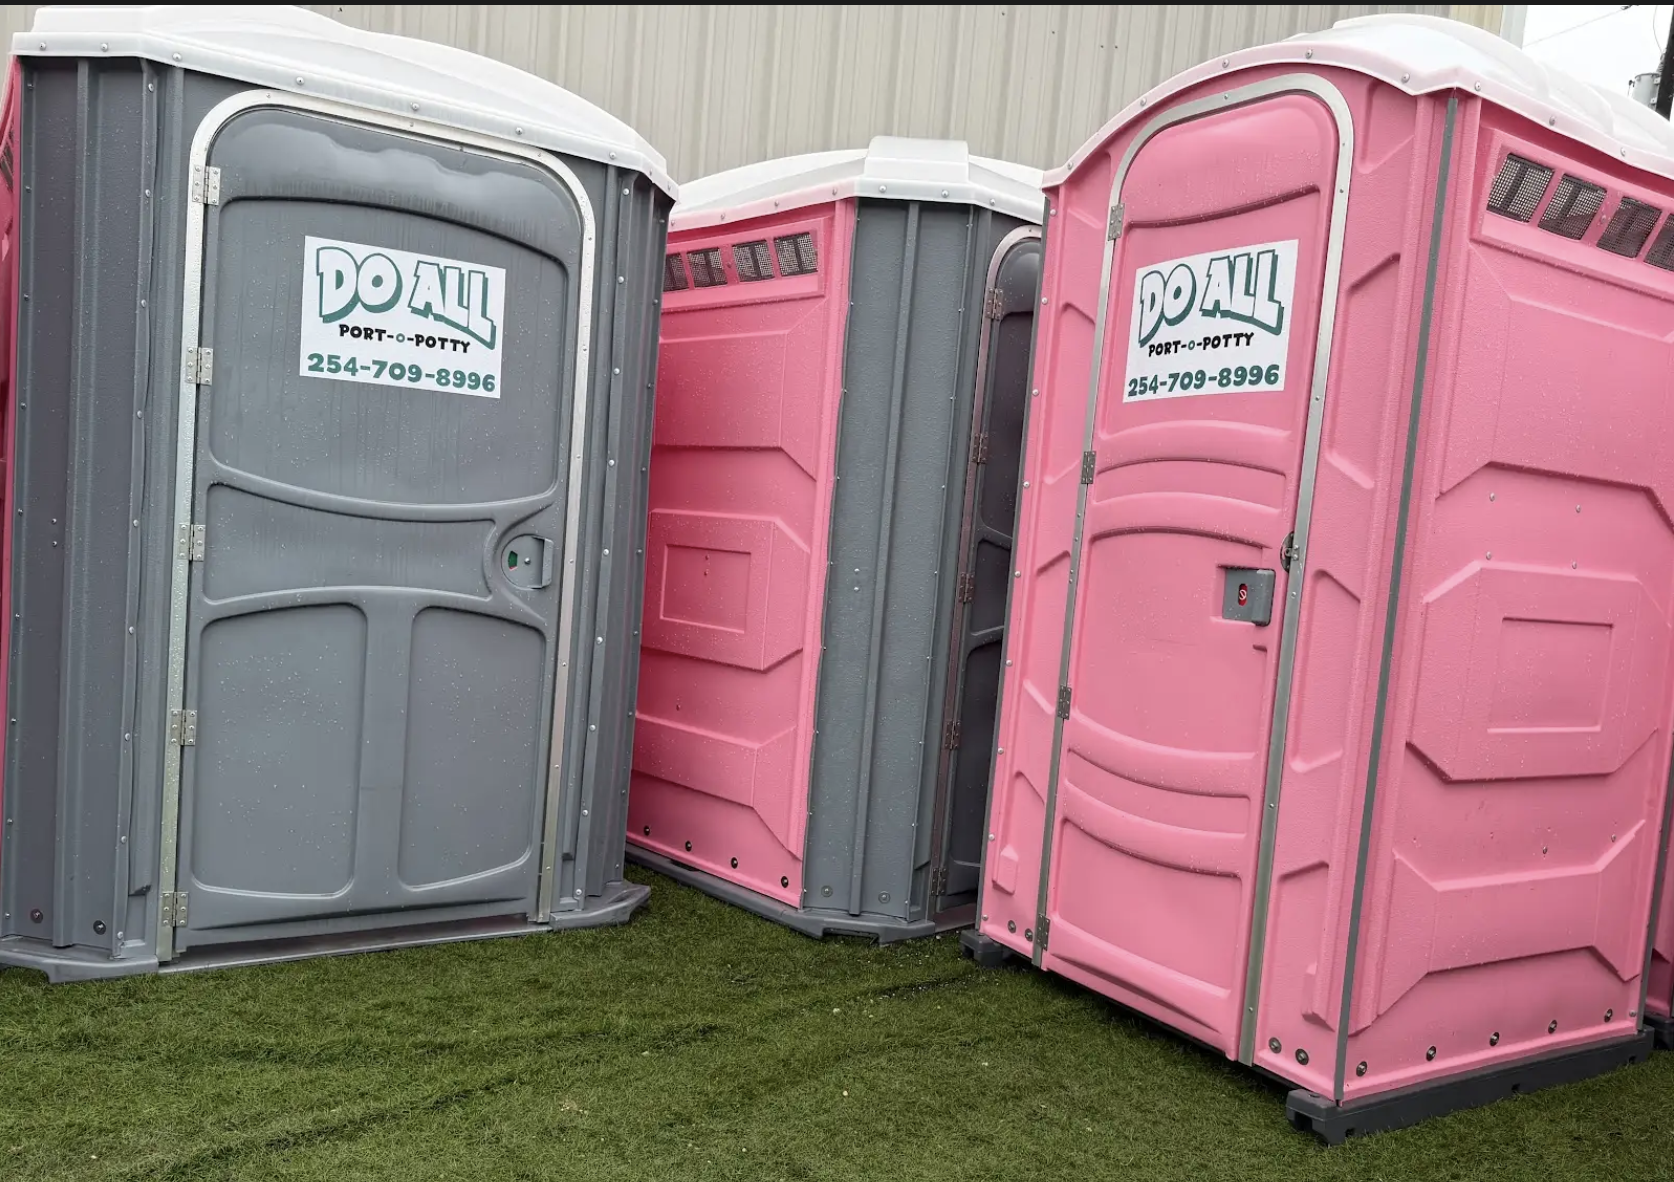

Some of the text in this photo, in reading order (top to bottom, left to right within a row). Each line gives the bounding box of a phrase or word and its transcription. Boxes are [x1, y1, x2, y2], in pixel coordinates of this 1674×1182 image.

[316, 246, 496, 350] DO ALL
[1138, 249, 1284, 348] DO ALL
[307, 353, 496, 392] 254-709-8996
[1128, 364, 1280, 397] 254-709-8996
